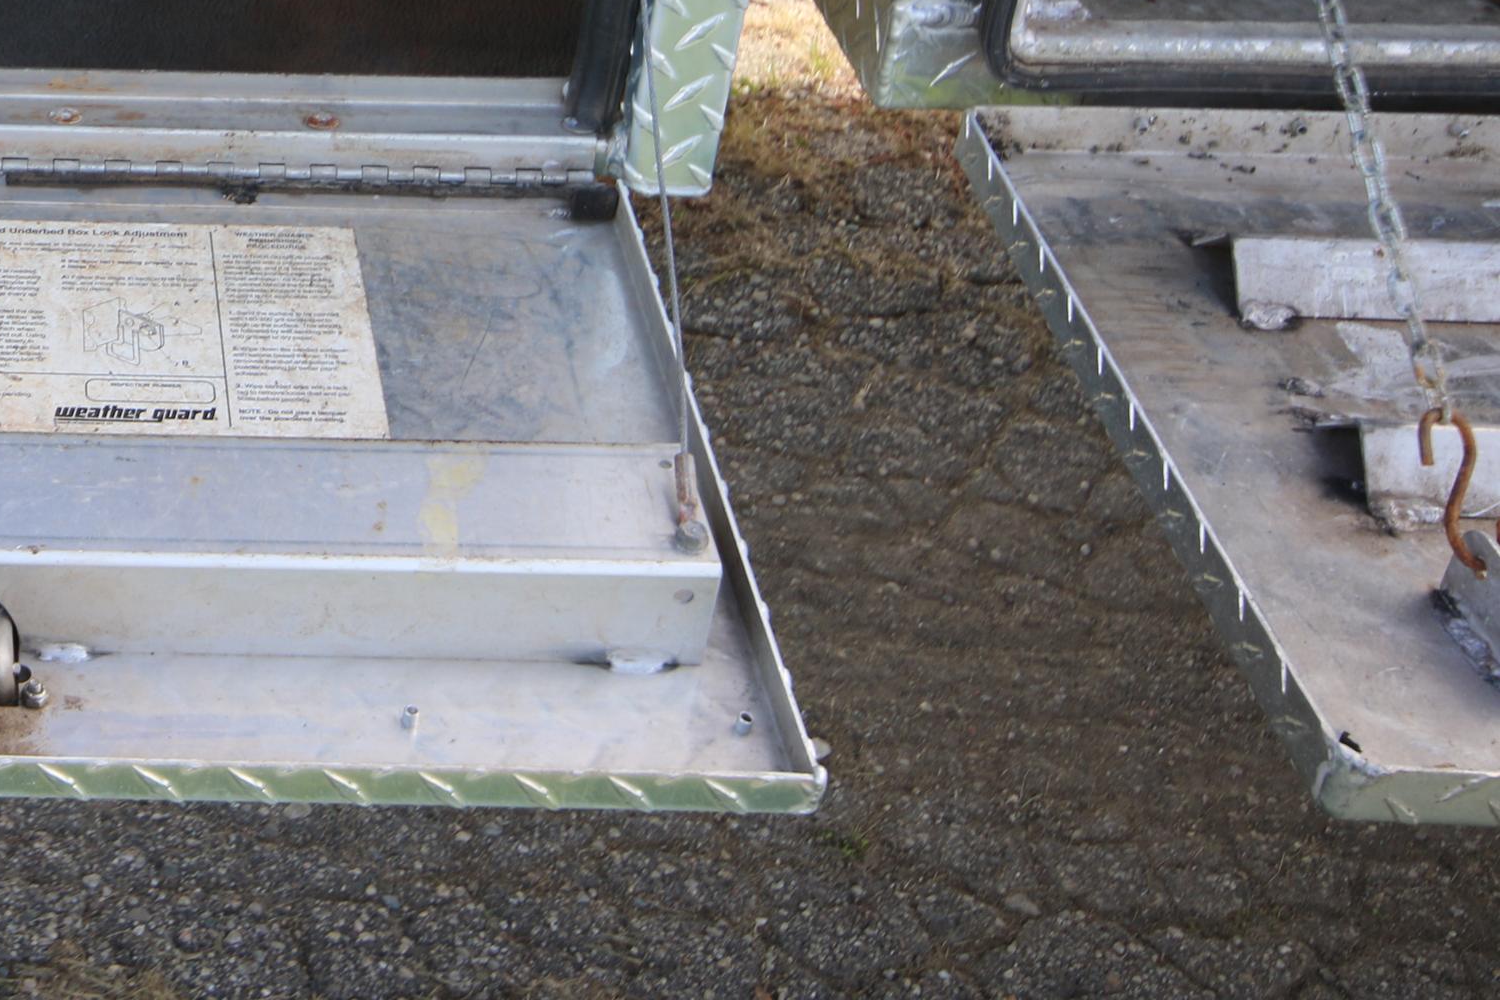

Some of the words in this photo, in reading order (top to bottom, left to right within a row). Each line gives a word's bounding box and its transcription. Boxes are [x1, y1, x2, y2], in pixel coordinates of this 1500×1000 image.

[124, 230, 187, 238] Adjustment
[54, 404, 147, 418] weather
[151, 406, 215, 422] guard
